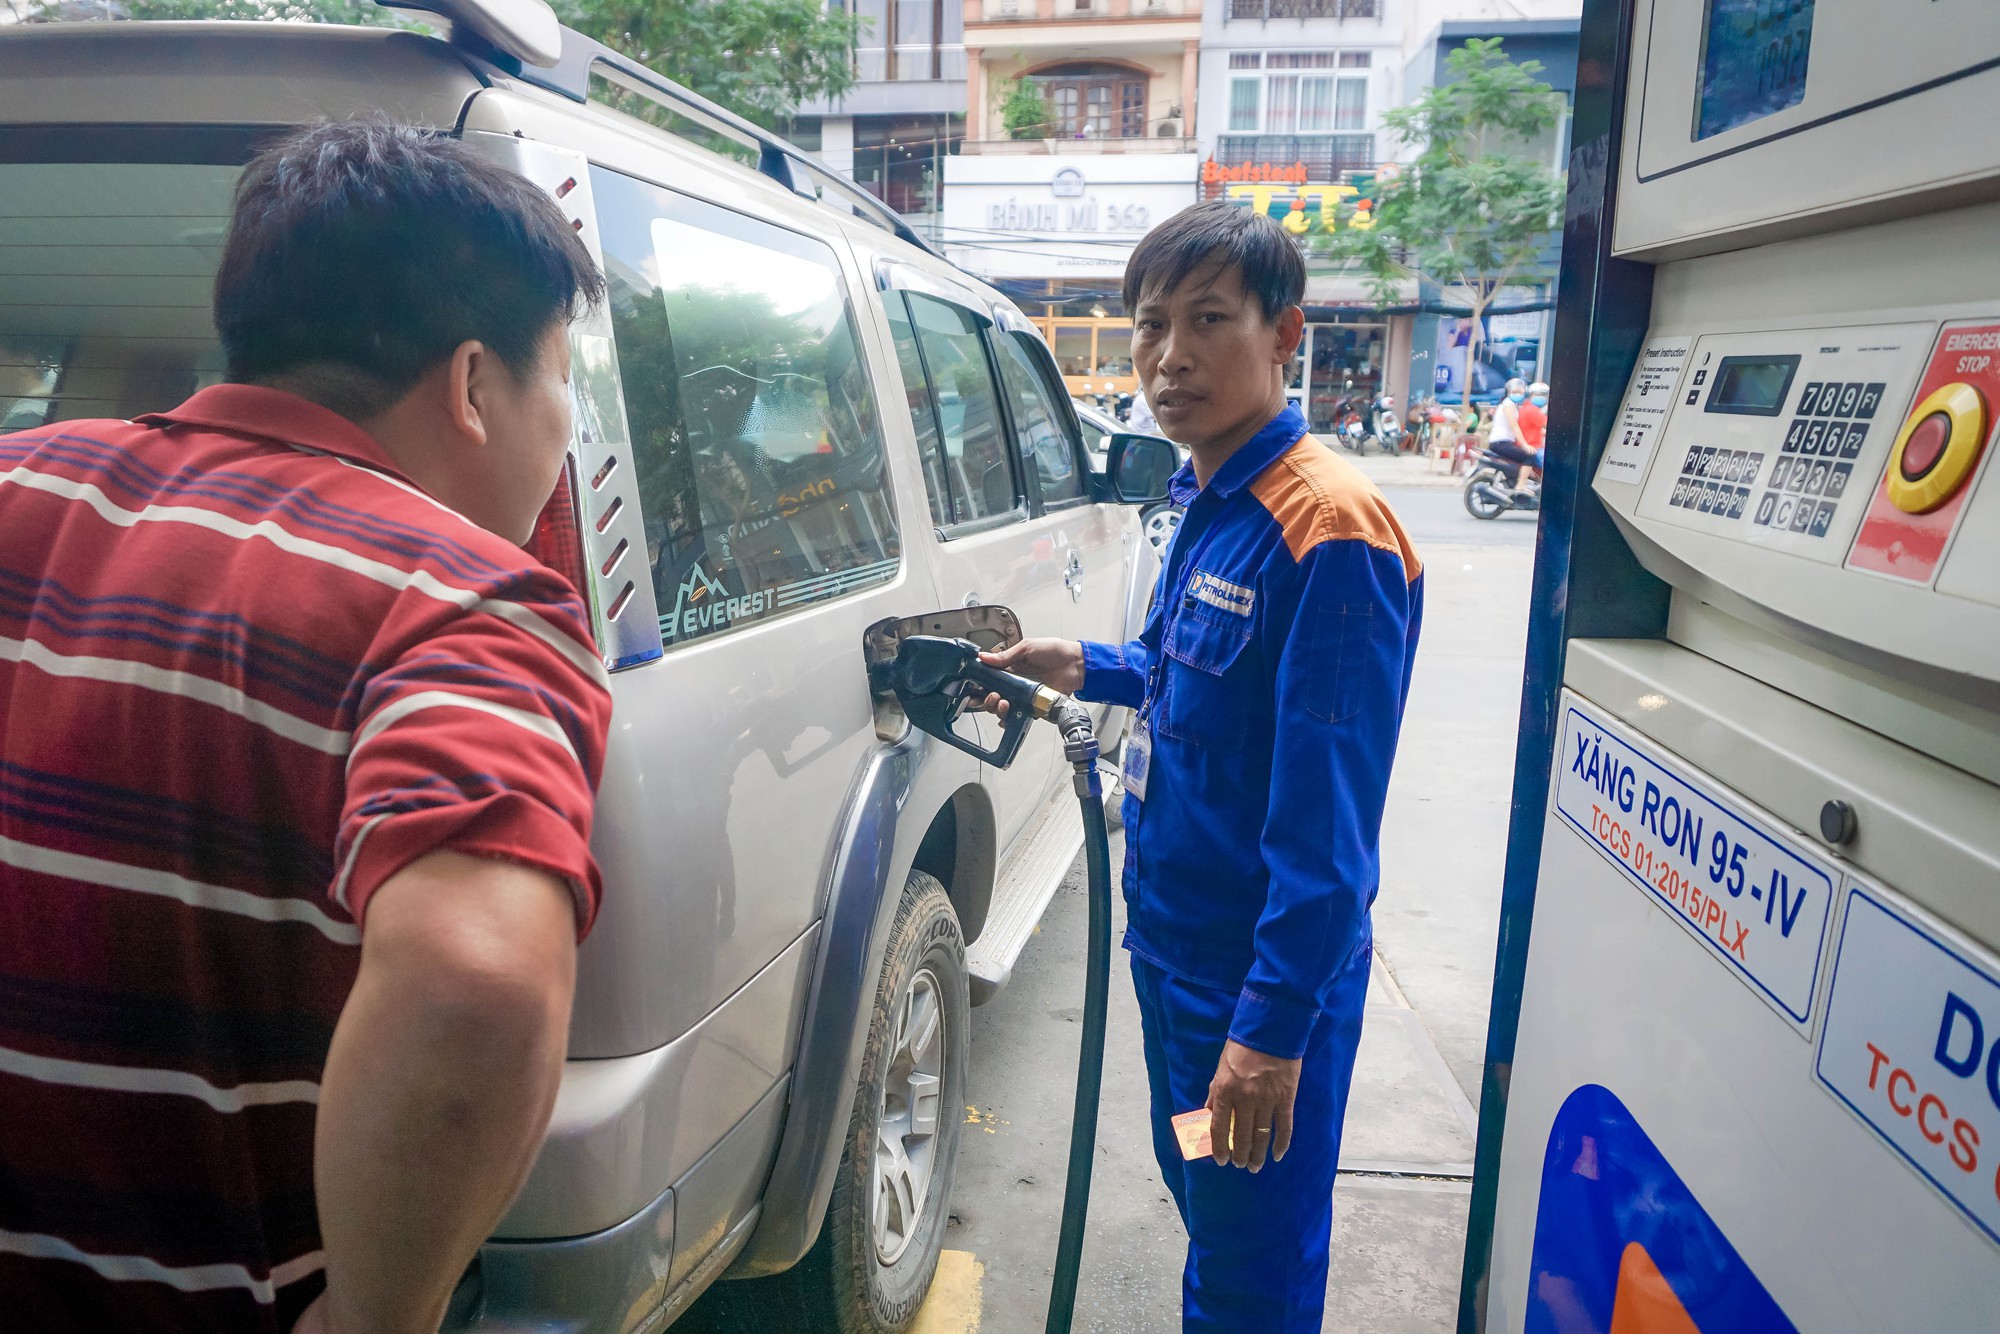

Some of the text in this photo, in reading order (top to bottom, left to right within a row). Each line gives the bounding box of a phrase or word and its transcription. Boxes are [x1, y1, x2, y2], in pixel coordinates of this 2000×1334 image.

[1202, 160, 1308, 184] Beefsteak
[988, 197, 1150, 231] BÁNH MÌ 362
[1645, 348, 1661, 358] Preset
[1956, 355, 1991, 374] STOP
[1802, 387, 1878, 413] 7 8 9 F1
[1789, 424, 1862, 452] 4 5 6 F2
[1685, 451, 1760, 478] P1 P2 P3 P4 P5
[1775, 463, 1847, 491] 1 2 3 F3
[1673, 483, 1748, 513] P6 P7 P8 P9 P10
[1760, 497, 1831, 528] 0 C F4
[1202, 582, 1250, 608] PETROLIMEX
[683, 588, 775, 634] EVEREST
[1572, 731, 1635, 813] XĂNG
[1641, 780, 1704, 867] RON
[1591, 803, 1750, 961] TCCS 01:2015/PLX
[1866, 1041, 1981, 1174] TCCS
